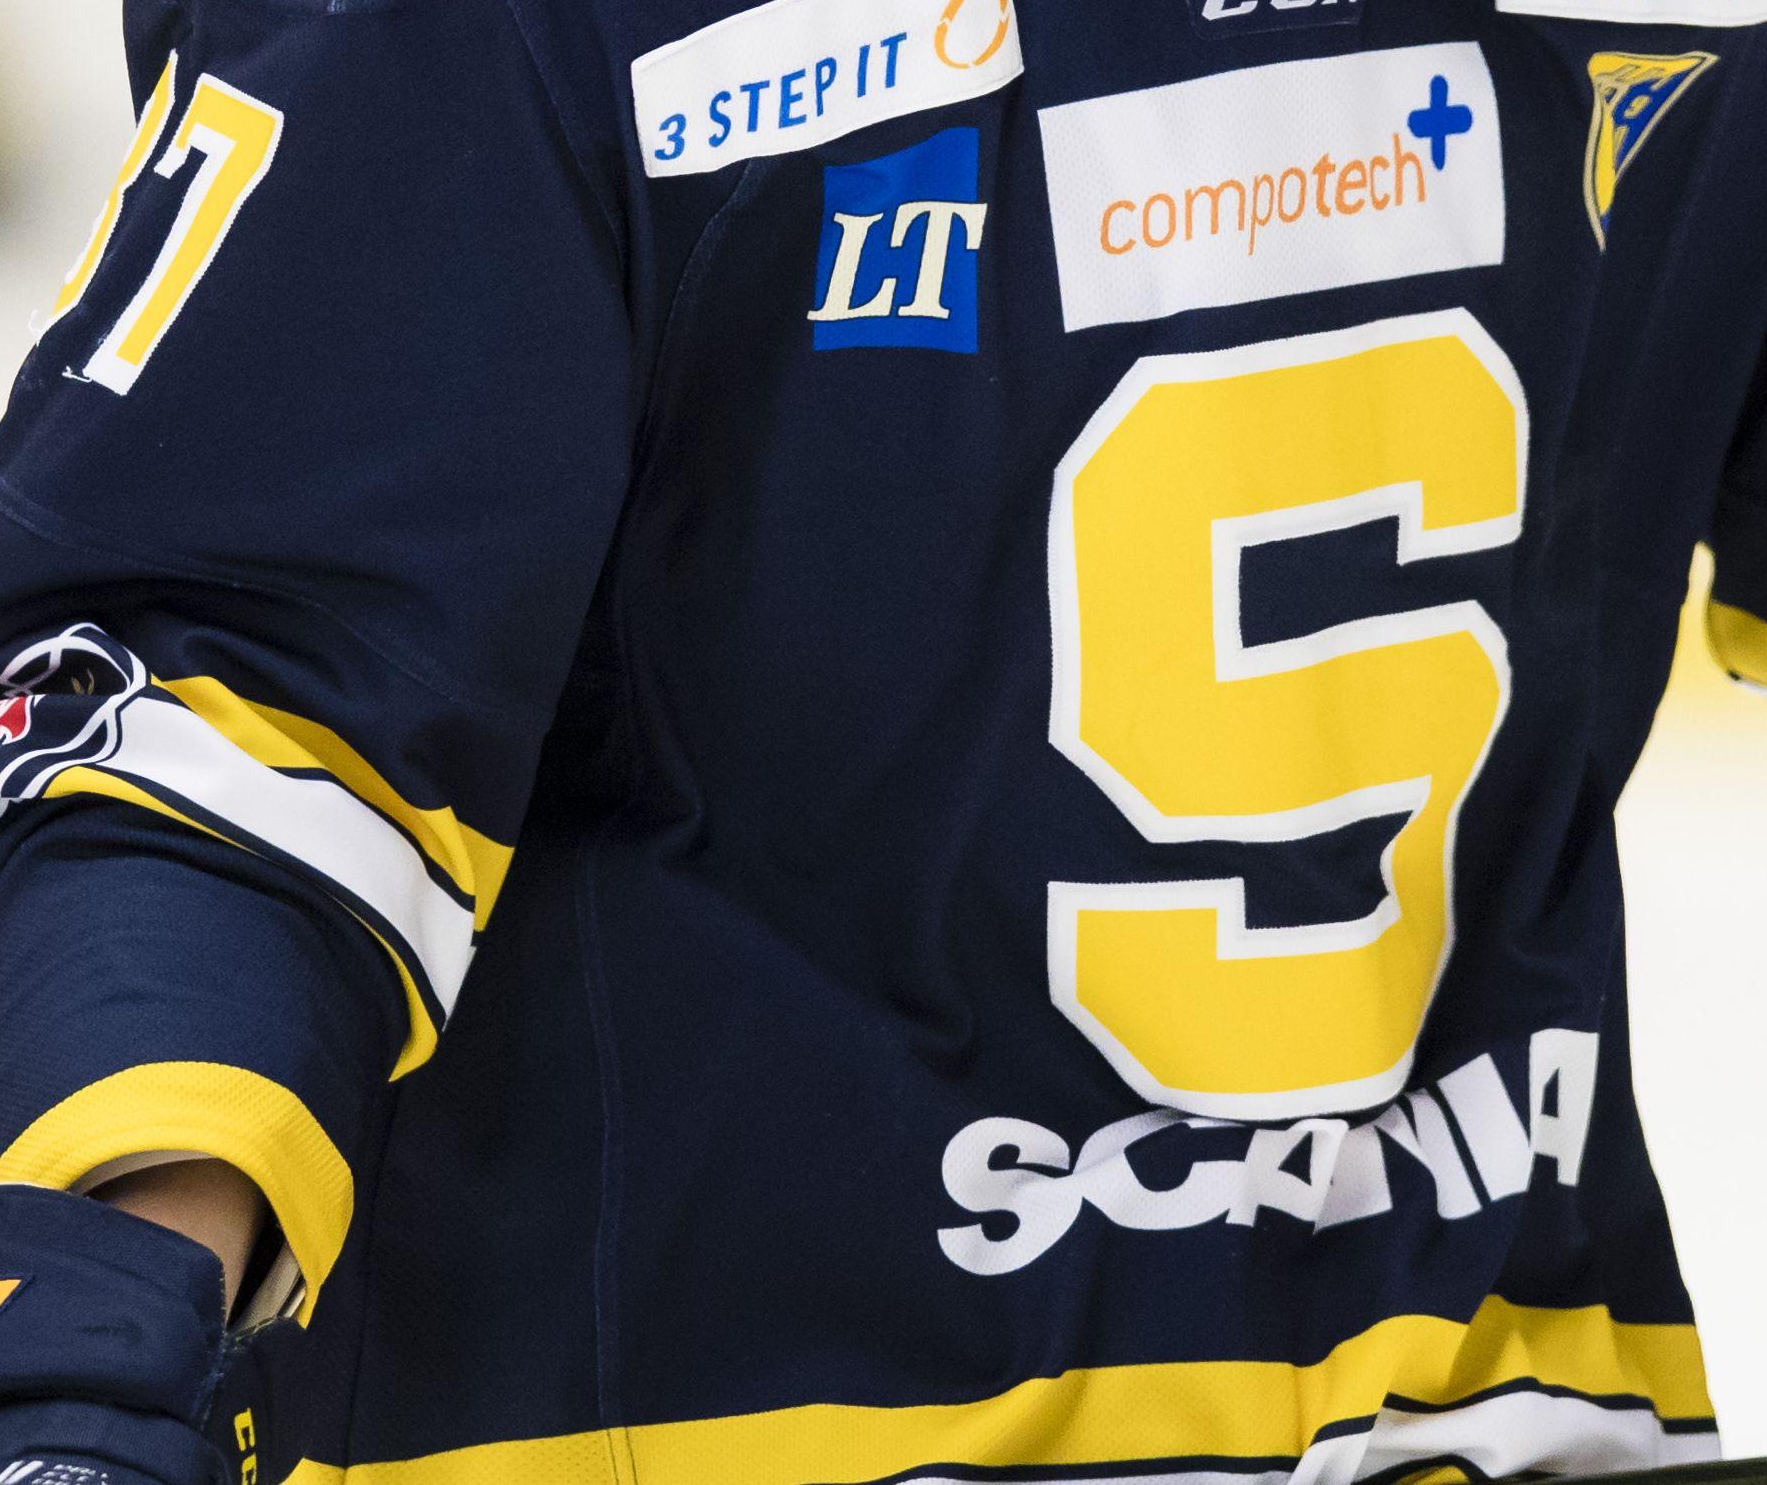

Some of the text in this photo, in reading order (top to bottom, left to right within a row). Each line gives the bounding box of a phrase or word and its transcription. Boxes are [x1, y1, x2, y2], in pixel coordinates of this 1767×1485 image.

[654, 31, 908, 162] 3 STEP IT
[30, 49, 285, 396] 7
[806, 199, 988, 322] LT
[1046, 306, 1531, 1121] S
